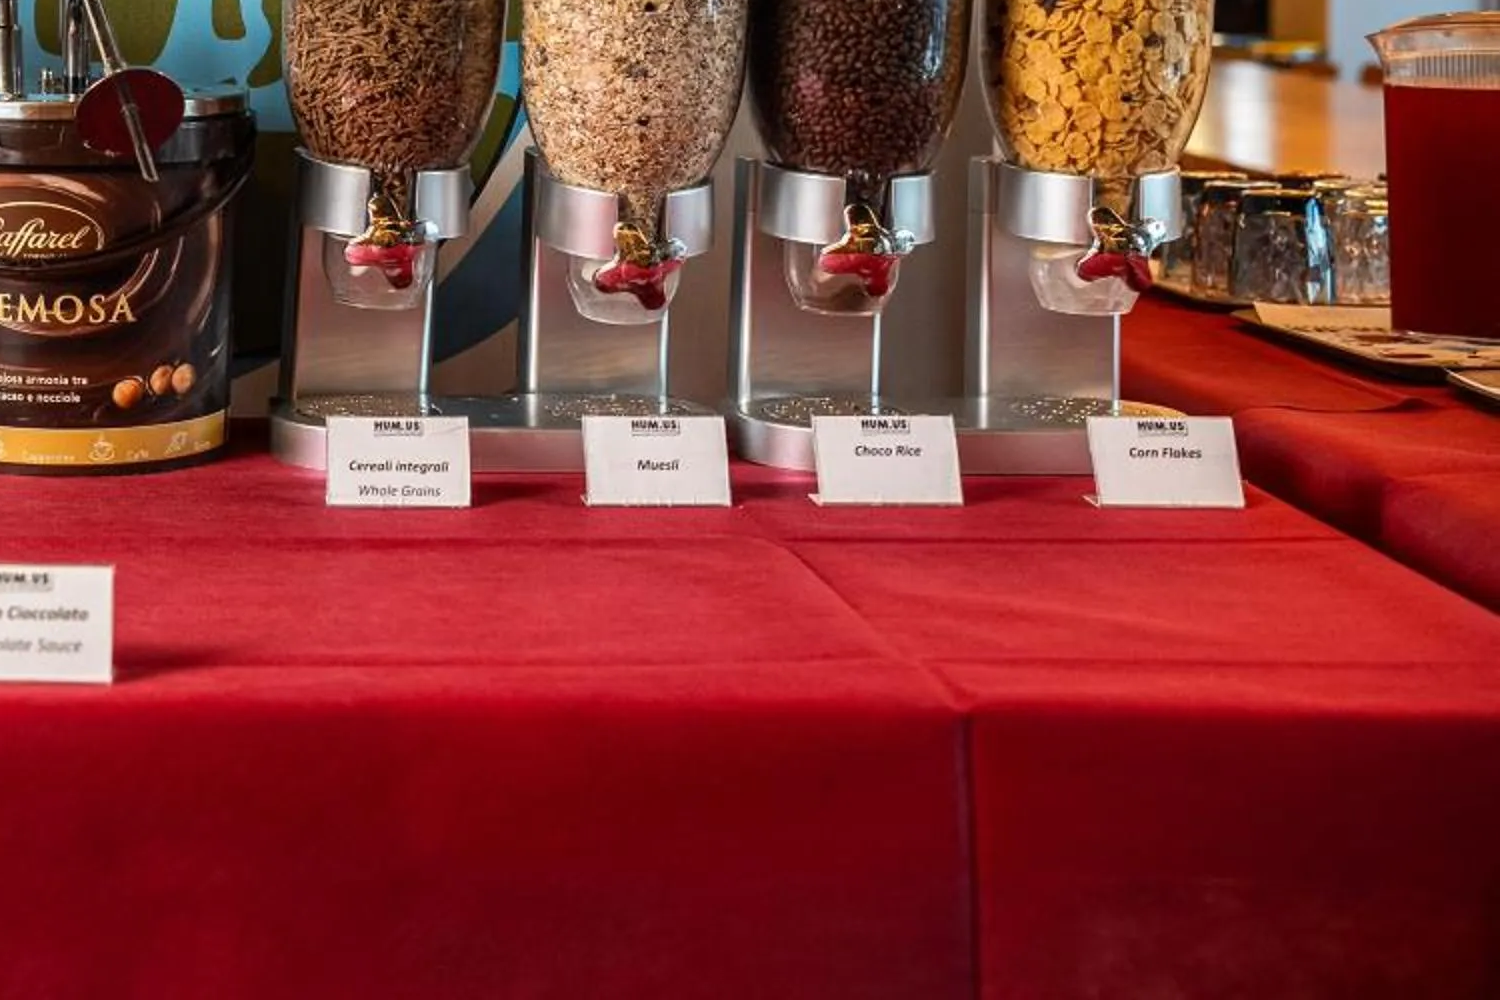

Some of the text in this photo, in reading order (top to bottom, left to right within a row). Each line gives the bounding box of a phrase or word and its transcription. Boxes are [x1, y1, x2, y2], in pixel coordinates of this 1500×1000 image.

[854, 445, 922, 457] Choco Rice
[1129, 447, 1202, 459] Corn Flakes
[349, 459, 449, 474] Cereali integrali
[637, 459, 680, 471] Muesli
[358, 485, 442, 497] Whole Grains
[7, 605, 89, 622] Cioccolato
[37, 638, 83, 653] Sauce
